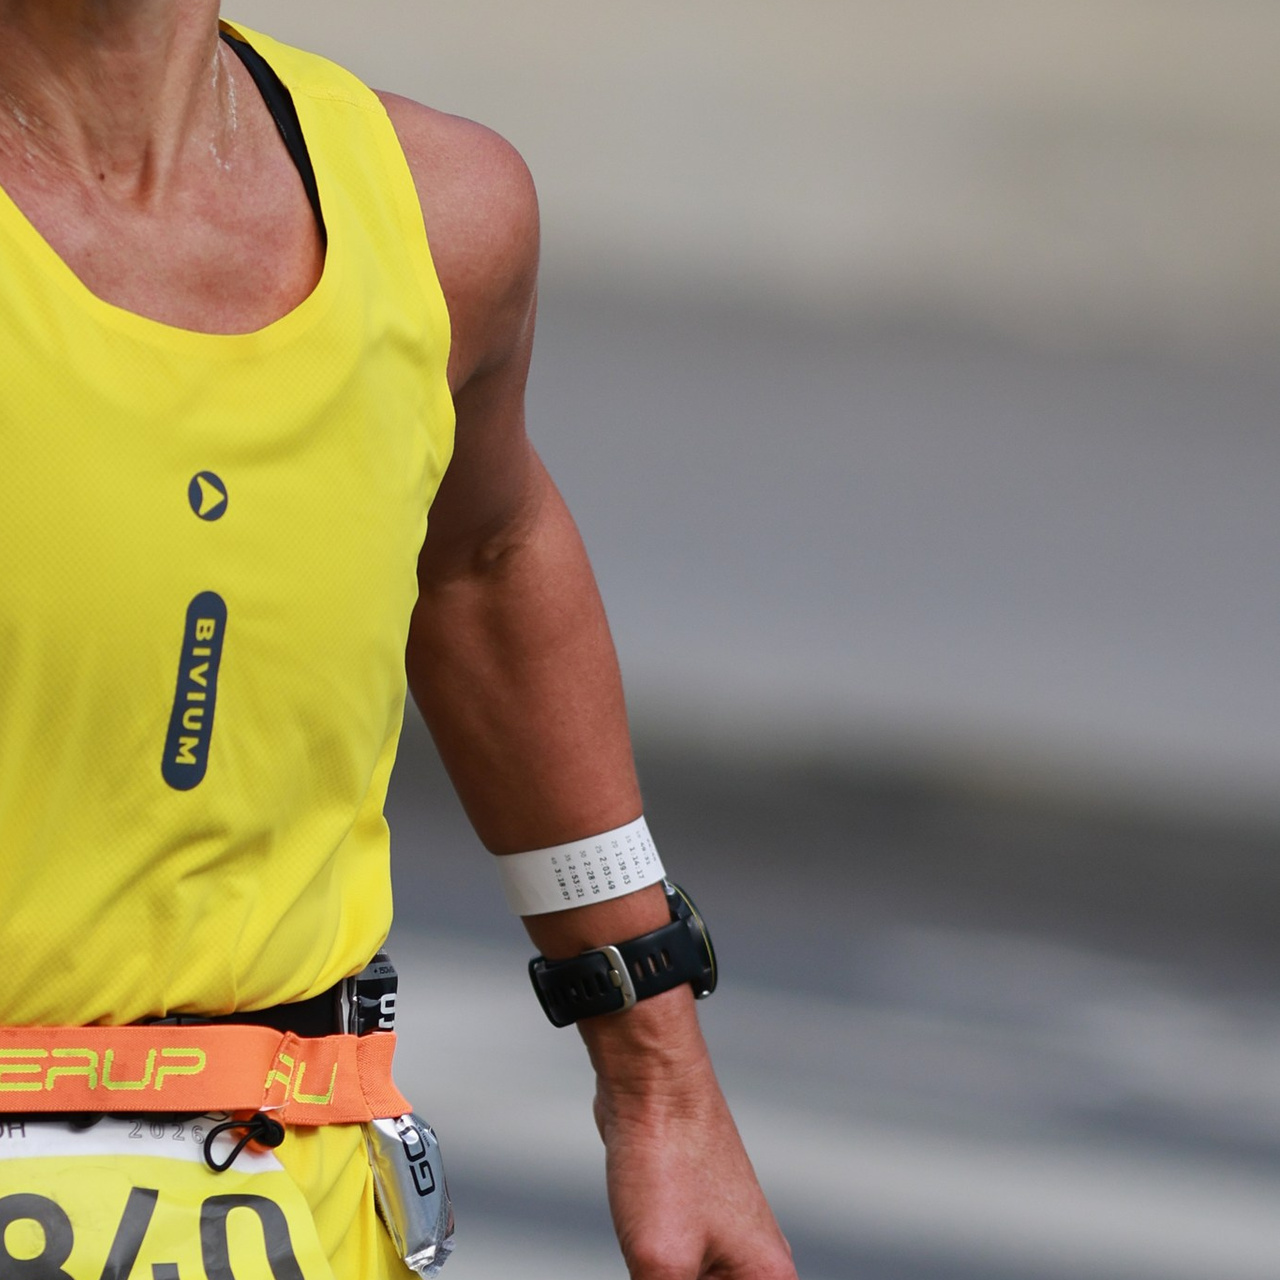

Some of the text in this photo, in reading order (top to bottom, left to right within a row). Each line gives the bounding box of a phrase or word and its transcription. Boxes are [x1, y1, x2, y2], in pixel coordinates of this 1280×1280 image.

[175, 618, 216, 765] BIVIUM
[568, 865, 585, 898] 2:53:21
[583, 861, 600, 895] 2:28:35
[128, 1120, 205, 1145] 2026
